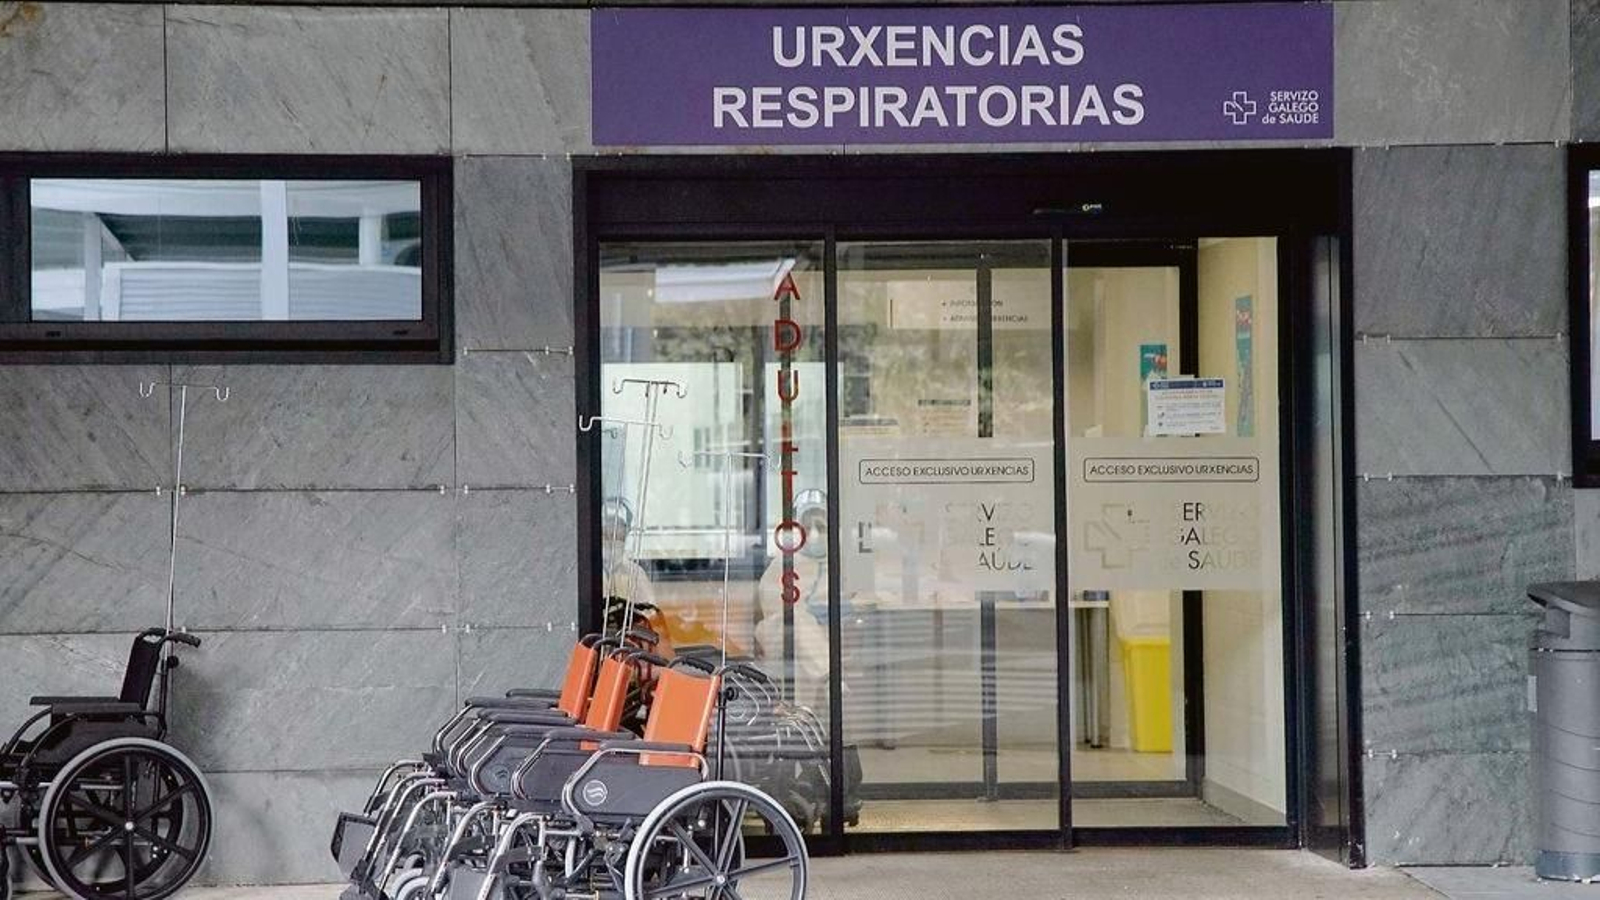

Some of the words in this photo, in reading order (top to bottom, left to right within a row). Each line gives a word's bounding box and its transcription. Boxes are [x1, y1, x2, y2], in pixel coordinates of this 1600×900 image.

[773, 24, 1084, 68] URXENCIAS
[1270, 90, 1319, 102] SERVIZO
[713, 84, 1145, 128] RESPIRATORIAS
[1268, 101, 1319, 113] GALEGO
[1262, 113, 1276, 124] de
[865, 466, 911, 477] ACCESO
[913, 466, 969, 477] EXCLUSIVO
[971, 466, 1029, 476] URXENCIAS
[1089, 465, 1136, 475] ACCESO
[1137, 464, 1194, 475] EXCLUSIVO
[1195, 464, 1254, 475] URXENCIAS
